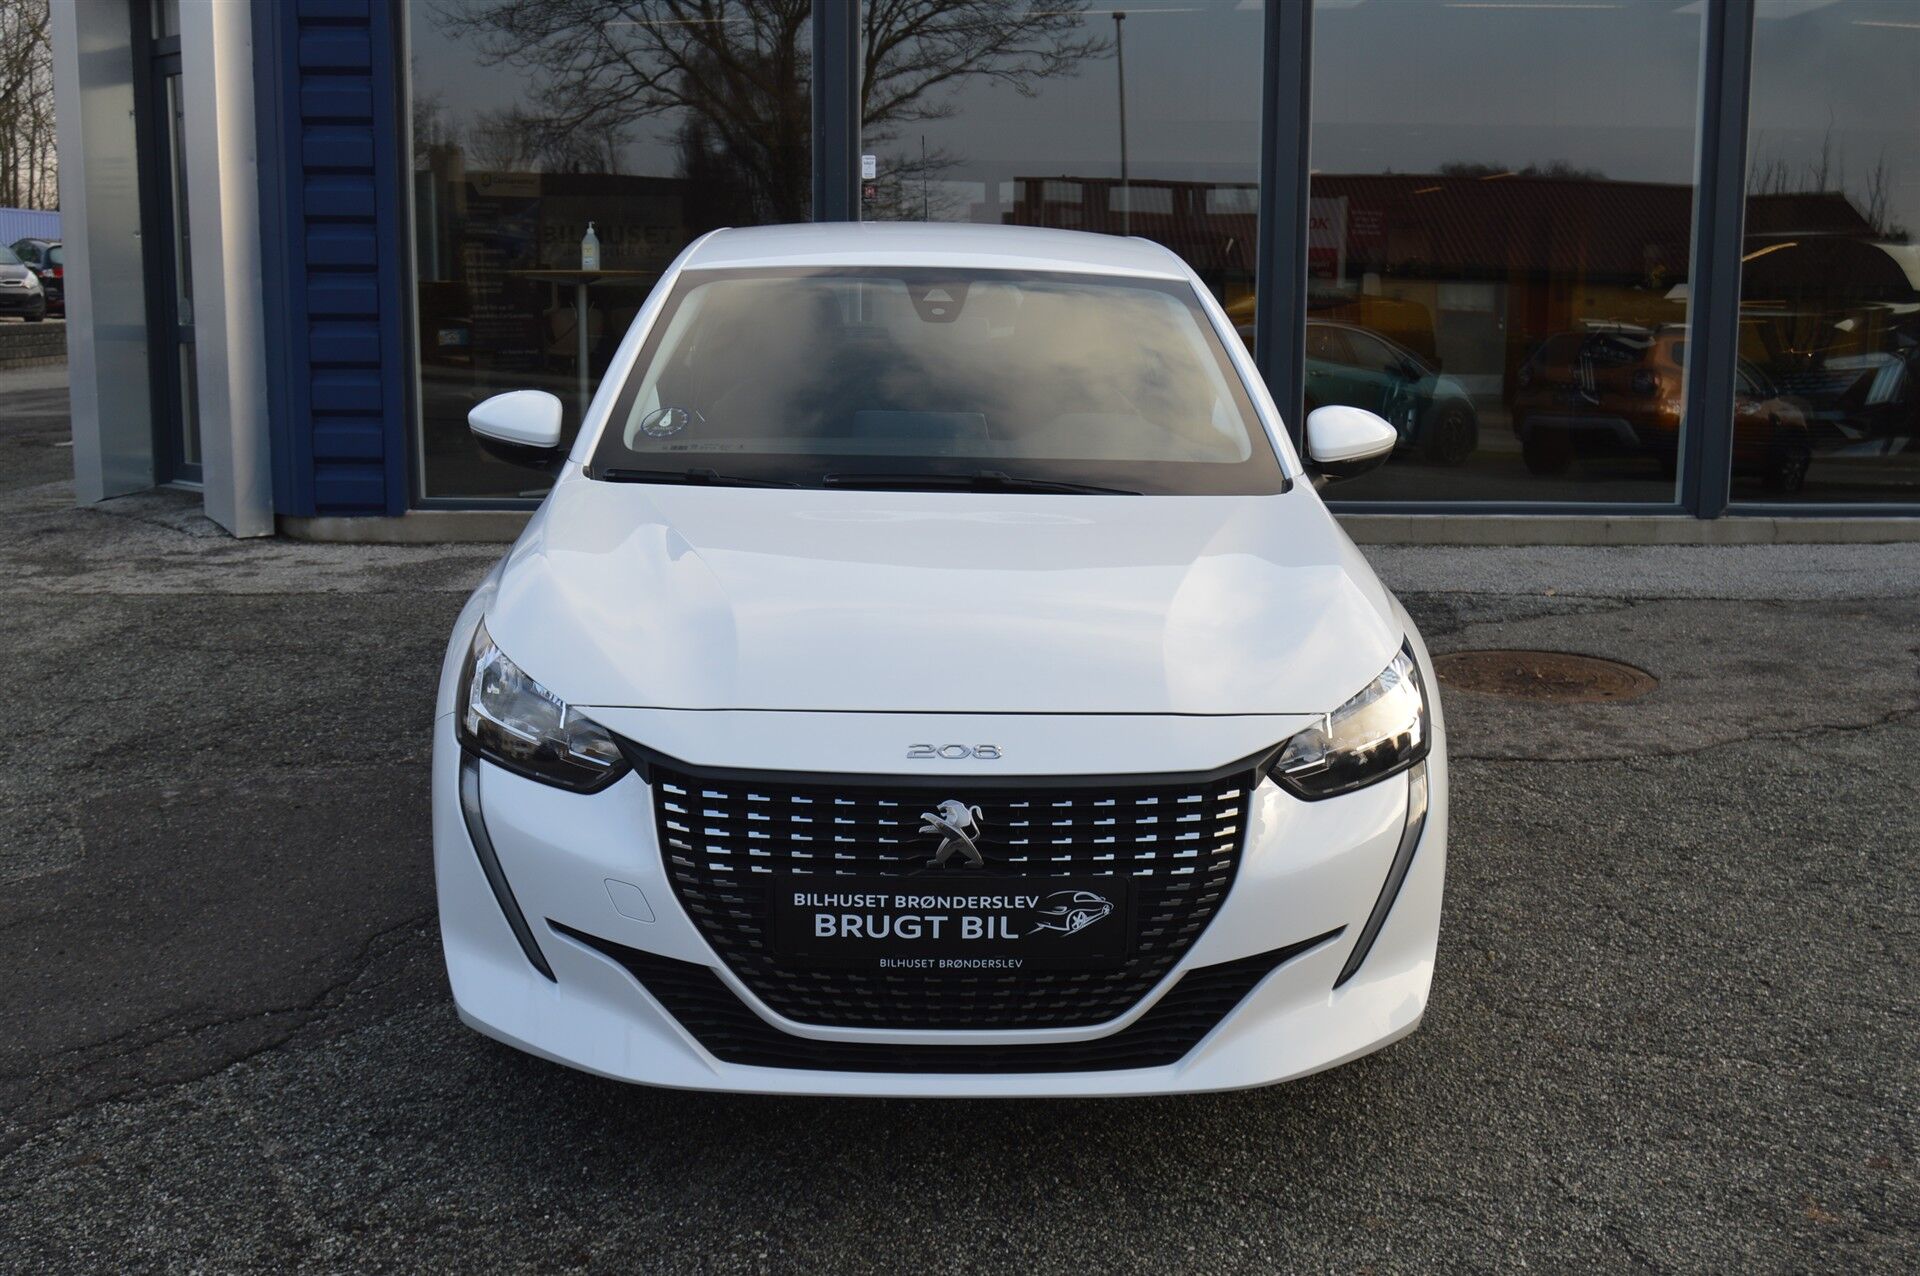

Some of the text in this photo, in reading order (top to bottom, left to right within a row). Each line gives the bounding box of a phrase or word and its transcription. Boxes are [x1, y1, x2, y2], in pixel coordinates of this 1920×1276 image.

[907, 744, 1002, 759] 208
[794, 893, 1039, 909] BILHUSET BRØNDERSLEV
[816, 914, 1018, 939] BRUGT BIL
[880, 959, 1022, 968] BILHUSET BRØNDERSLEV
